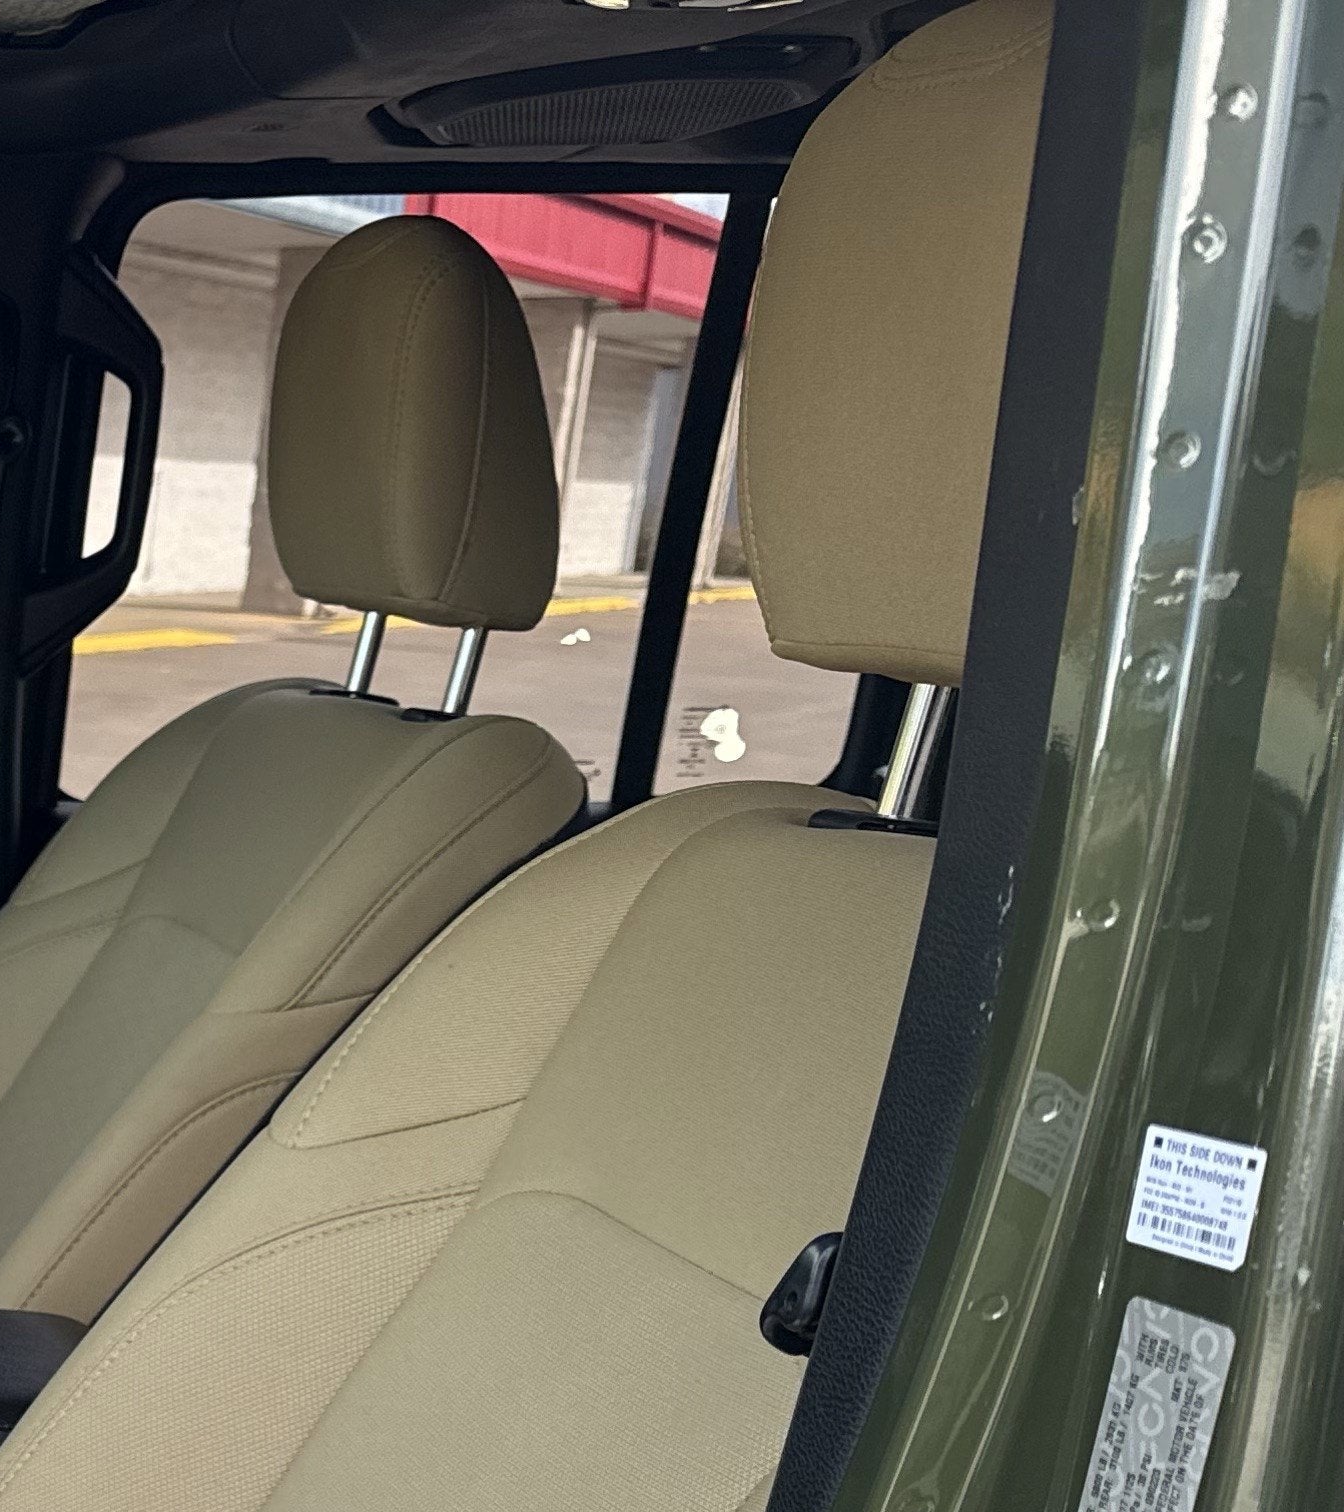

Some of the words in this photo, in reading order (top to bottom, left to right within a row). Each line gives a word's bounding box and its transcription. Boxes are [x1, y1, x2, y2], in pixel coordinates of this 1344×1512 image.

[1166, 1138, 1187, 1154] THIS
[1189, 1144, 1210, 1160] SIDE
[1213, 1149, 1243, 1168] DOWN
[1149, 1153, 1173, 1172] Ikon
[1175, 1160, 1245, 1189] Technologies
